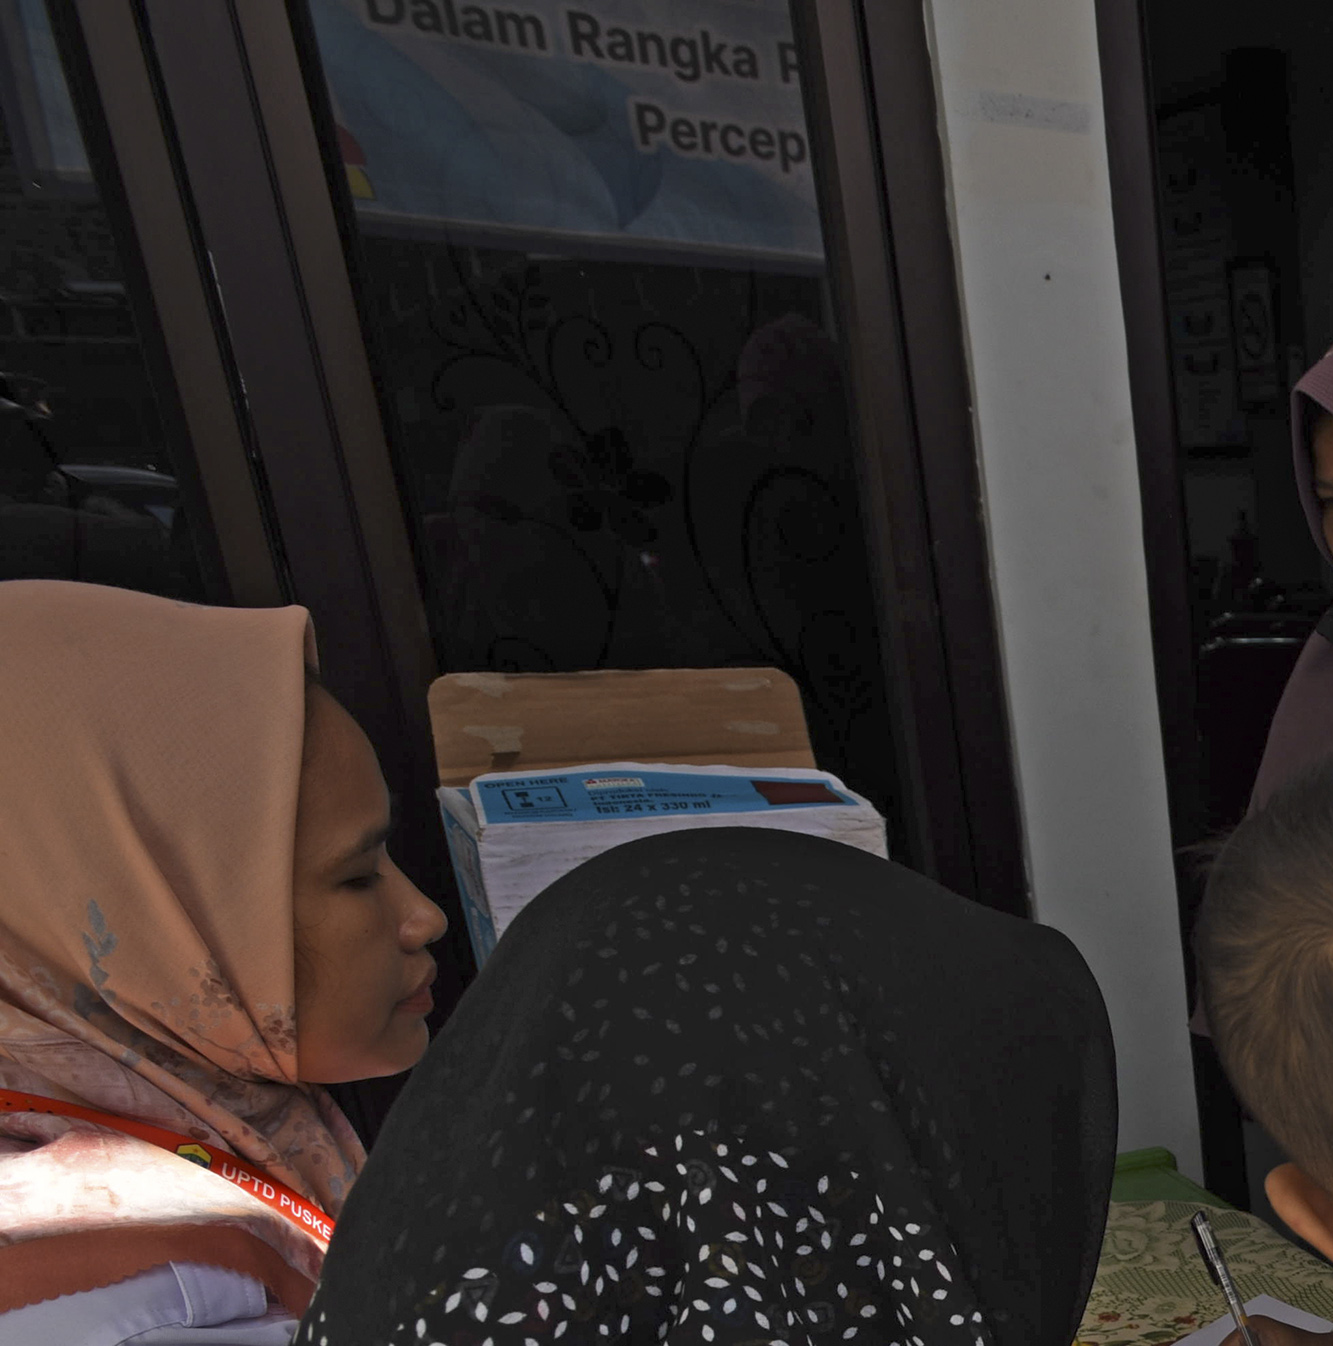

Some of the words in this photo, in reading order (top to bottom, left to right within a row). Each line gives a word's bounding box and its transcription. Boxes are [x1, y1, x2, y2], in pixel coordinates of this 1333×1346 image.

[367, 0, 548, 50] Dalam
[567, 9, 759, 82] Rangka
[634, 102, 806, 174] Percep
[484, 781, 526, 789] OPEN
[529, 777, 568, 786] HERE
[596, 805, 620, 814] Isi:
[624, 803, 643, 813] 24
[647, 804, 658, 812] x
[661, 801, 689, 811] 330
[692, 800, 711, 809] ml
[221, 1162, 276, 1200] UPTD
[279, 1193, 332, 1241] PUSKE
